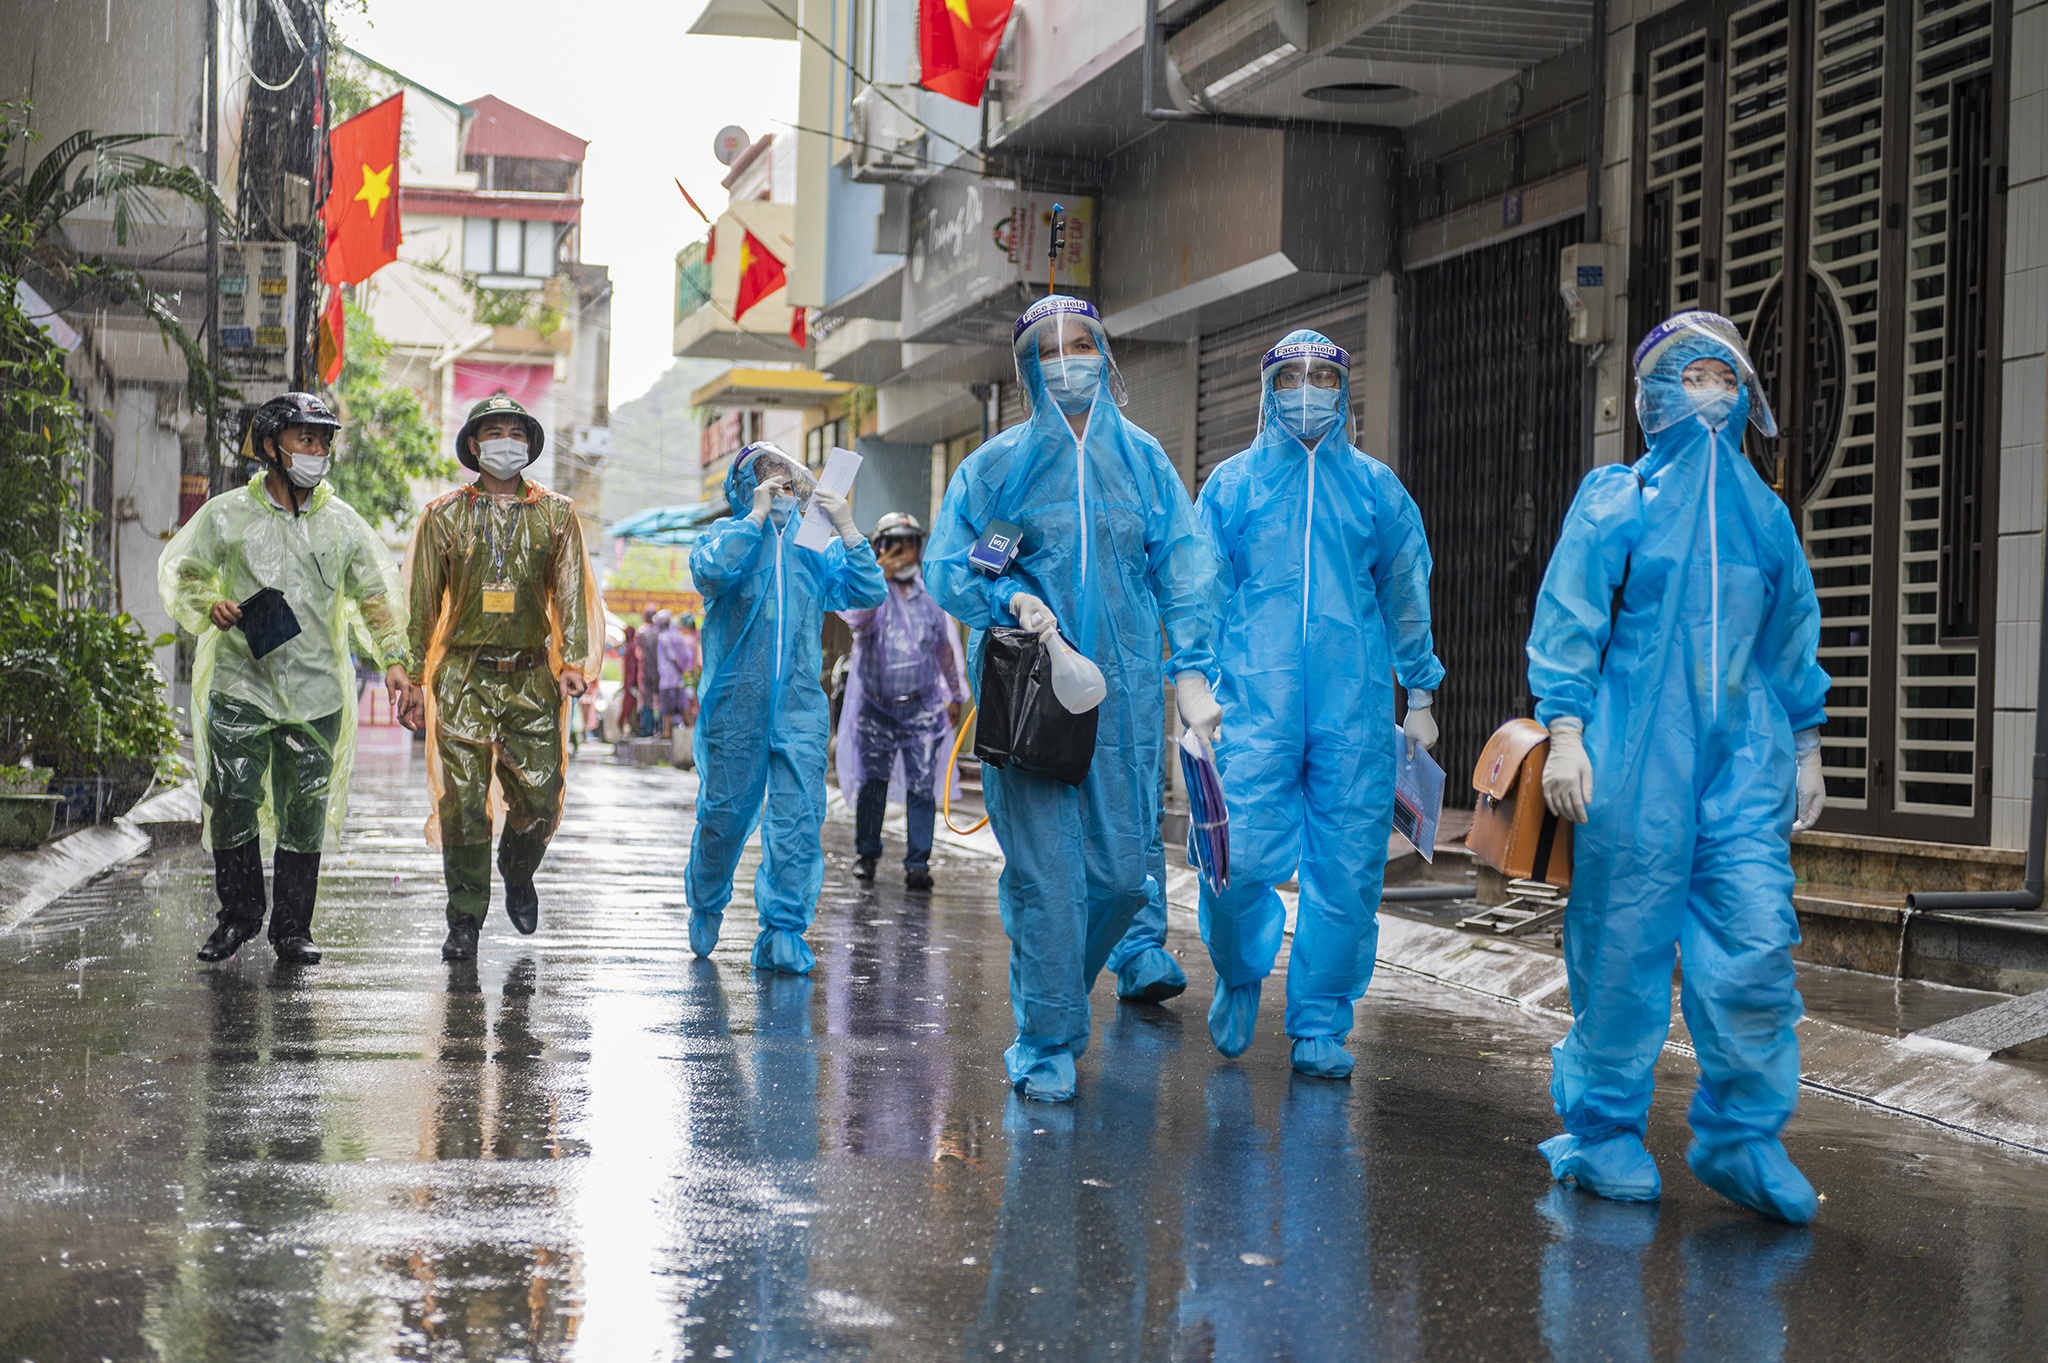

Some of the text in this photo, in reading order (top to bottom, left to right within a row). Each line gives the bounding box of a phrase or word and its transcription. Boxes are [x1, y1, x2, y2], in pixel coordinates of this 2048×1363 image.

[1024, 299, 1086, 322] Face Shield
[1276, 344, 1335, 356] Face Shield
